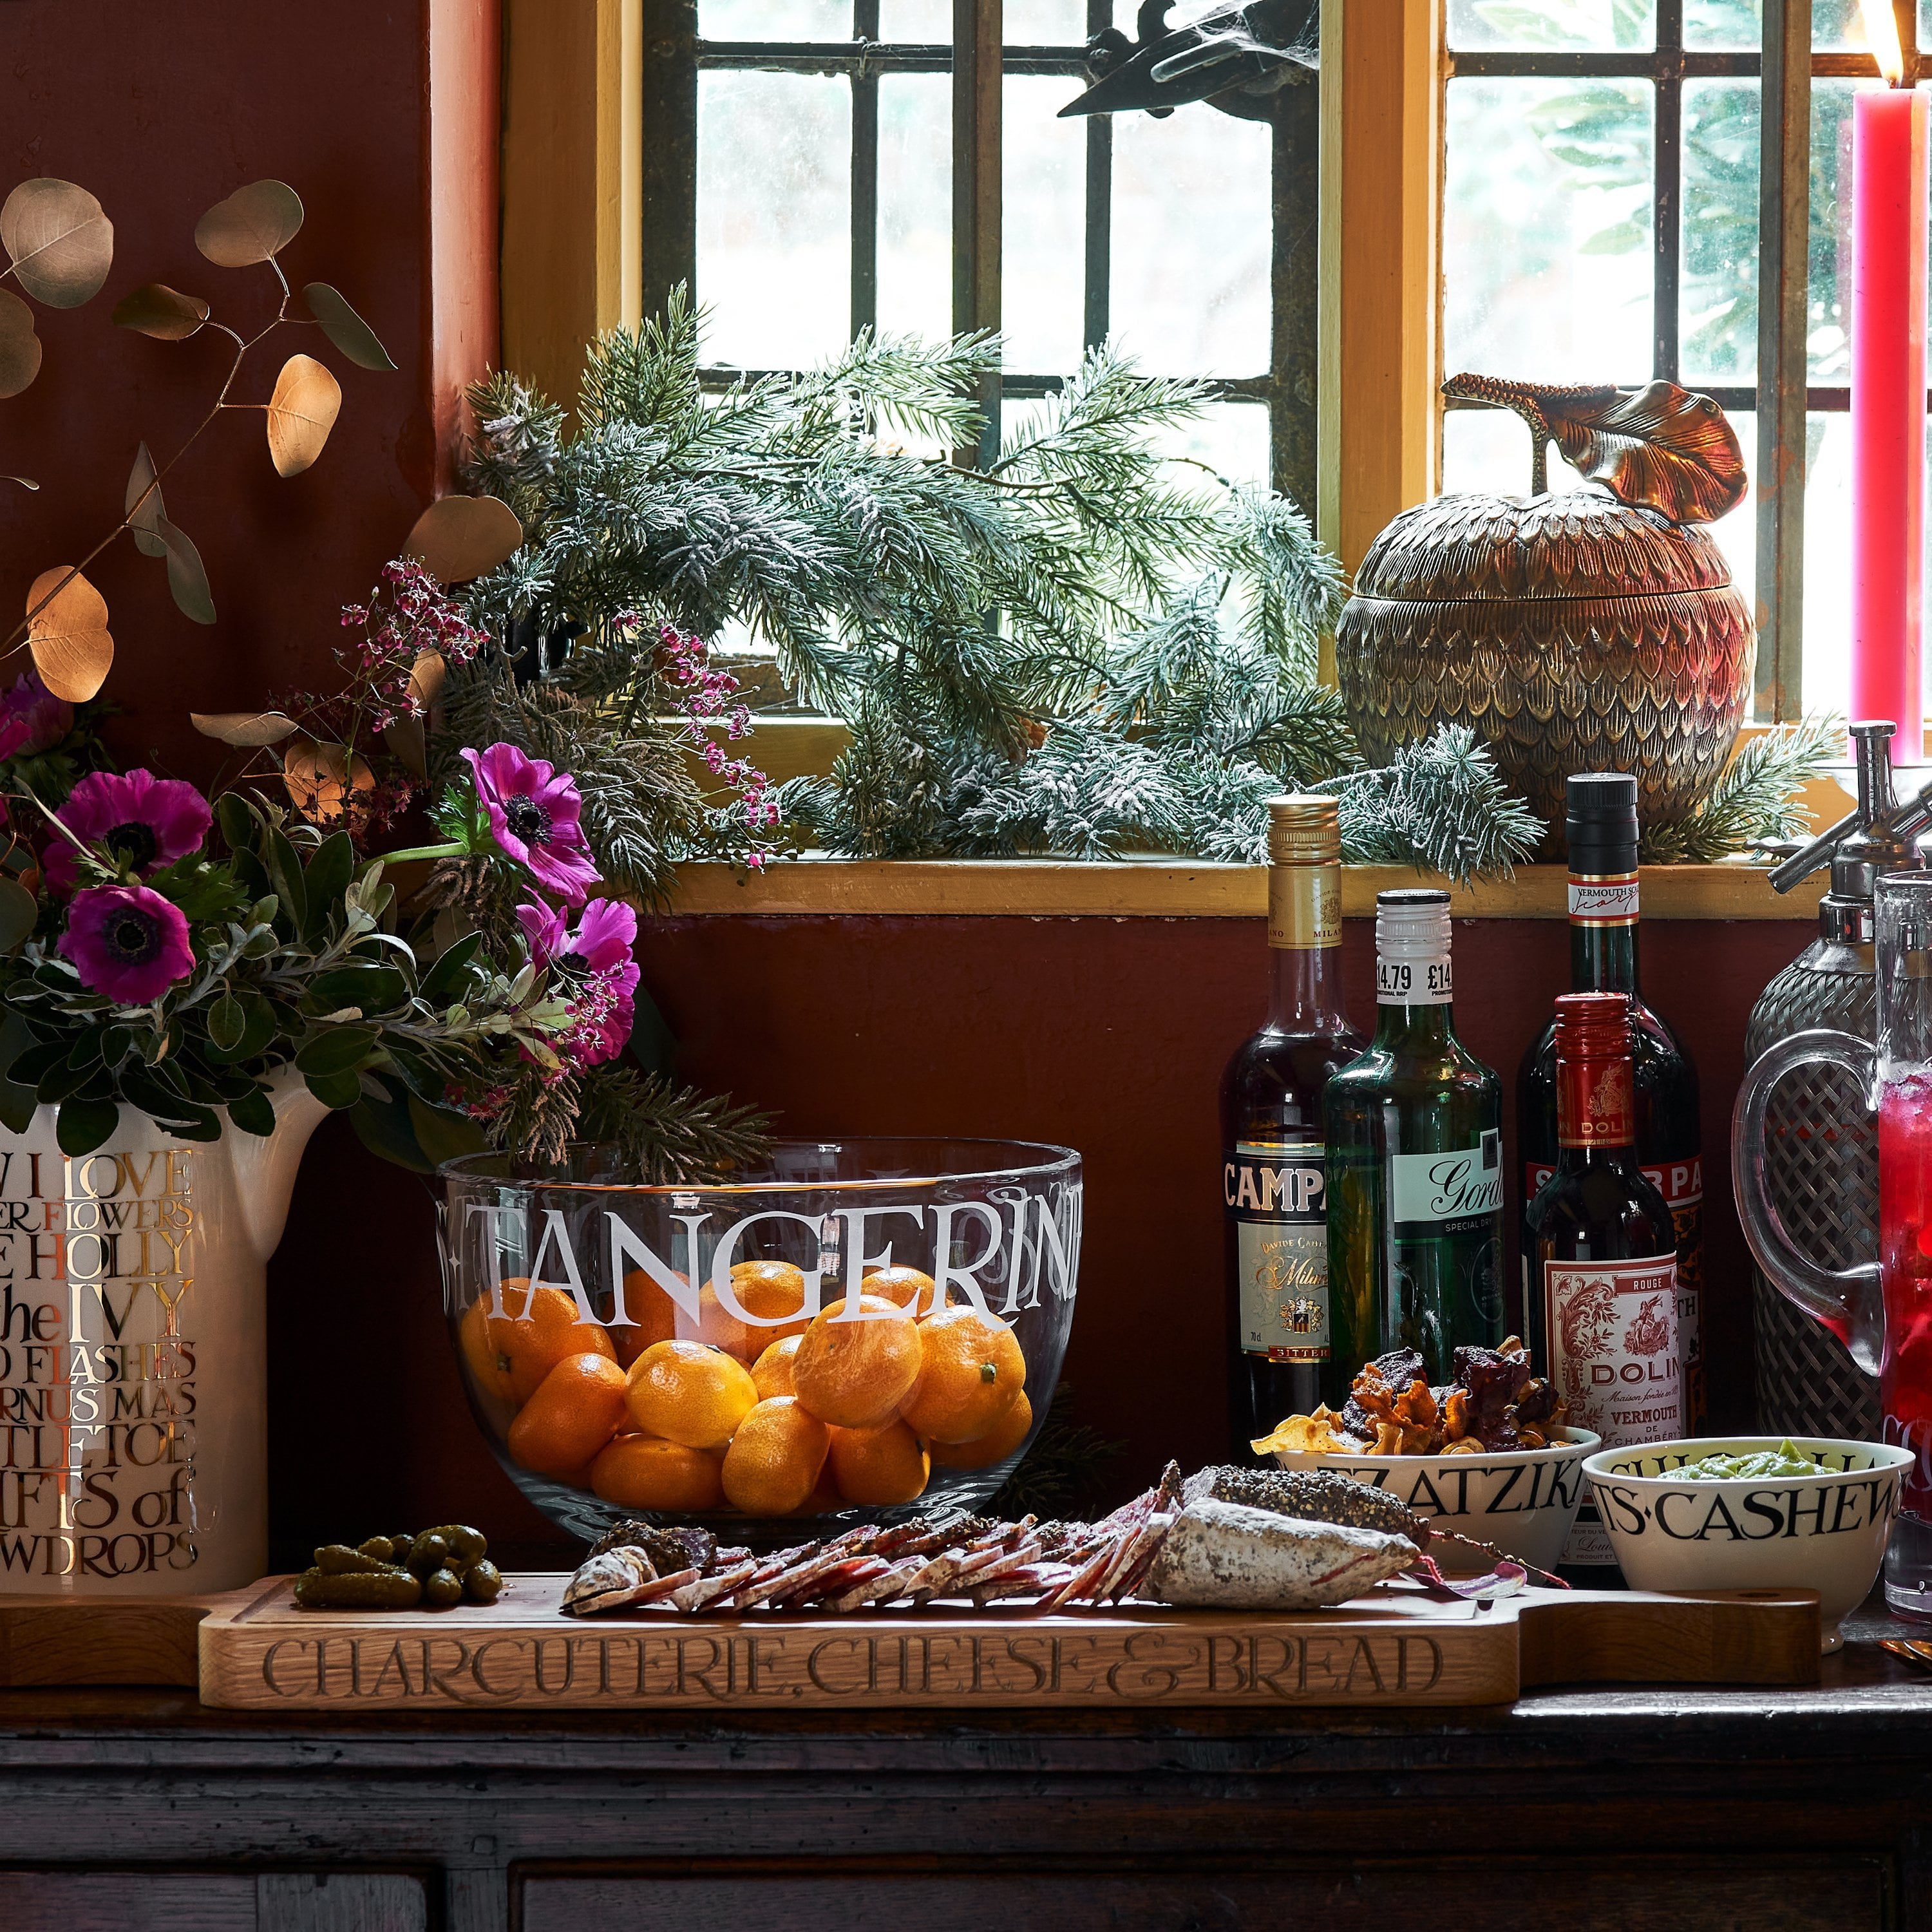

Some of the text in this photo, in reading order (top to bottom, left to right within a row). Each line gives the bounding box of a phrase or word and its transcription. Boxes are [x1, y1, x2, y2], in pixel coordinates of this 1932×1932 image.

[1577, 888, 1627, 896] VERMOUTH
[26, 1153, 44, 1198] I
[62, 1149, 193, 1200] LOVE
[41, 1198, 194, 1231] FLOWERS
[1445, 1217, 1493, 1232] SPECIAL DRY
[25, 1229, 193, 1280] HOLLY
[1633, 1278, 1662, 1291] ROUGE
[0, 1279, 194, 1343] he IVY
[22, 1341, 196, 1384] FLASHES
[1591, 1356, 1680, 1386] DOLIN
[109, 1382, 196, 1421] MAS
[1602, 1390, 1642, 1403] Maison
[1611, 1405, 1677, 1426] VERMOUTH
[1615, 1431, 1677, 1446] CHAMBÉRY
[132, 1466, 196, 1529] of
[1587, 1479, 1645, 1535] TS
[807, 1636, 1099, 1696] CHEESE
[1206, 1635, 1443, 1701] BREAD
